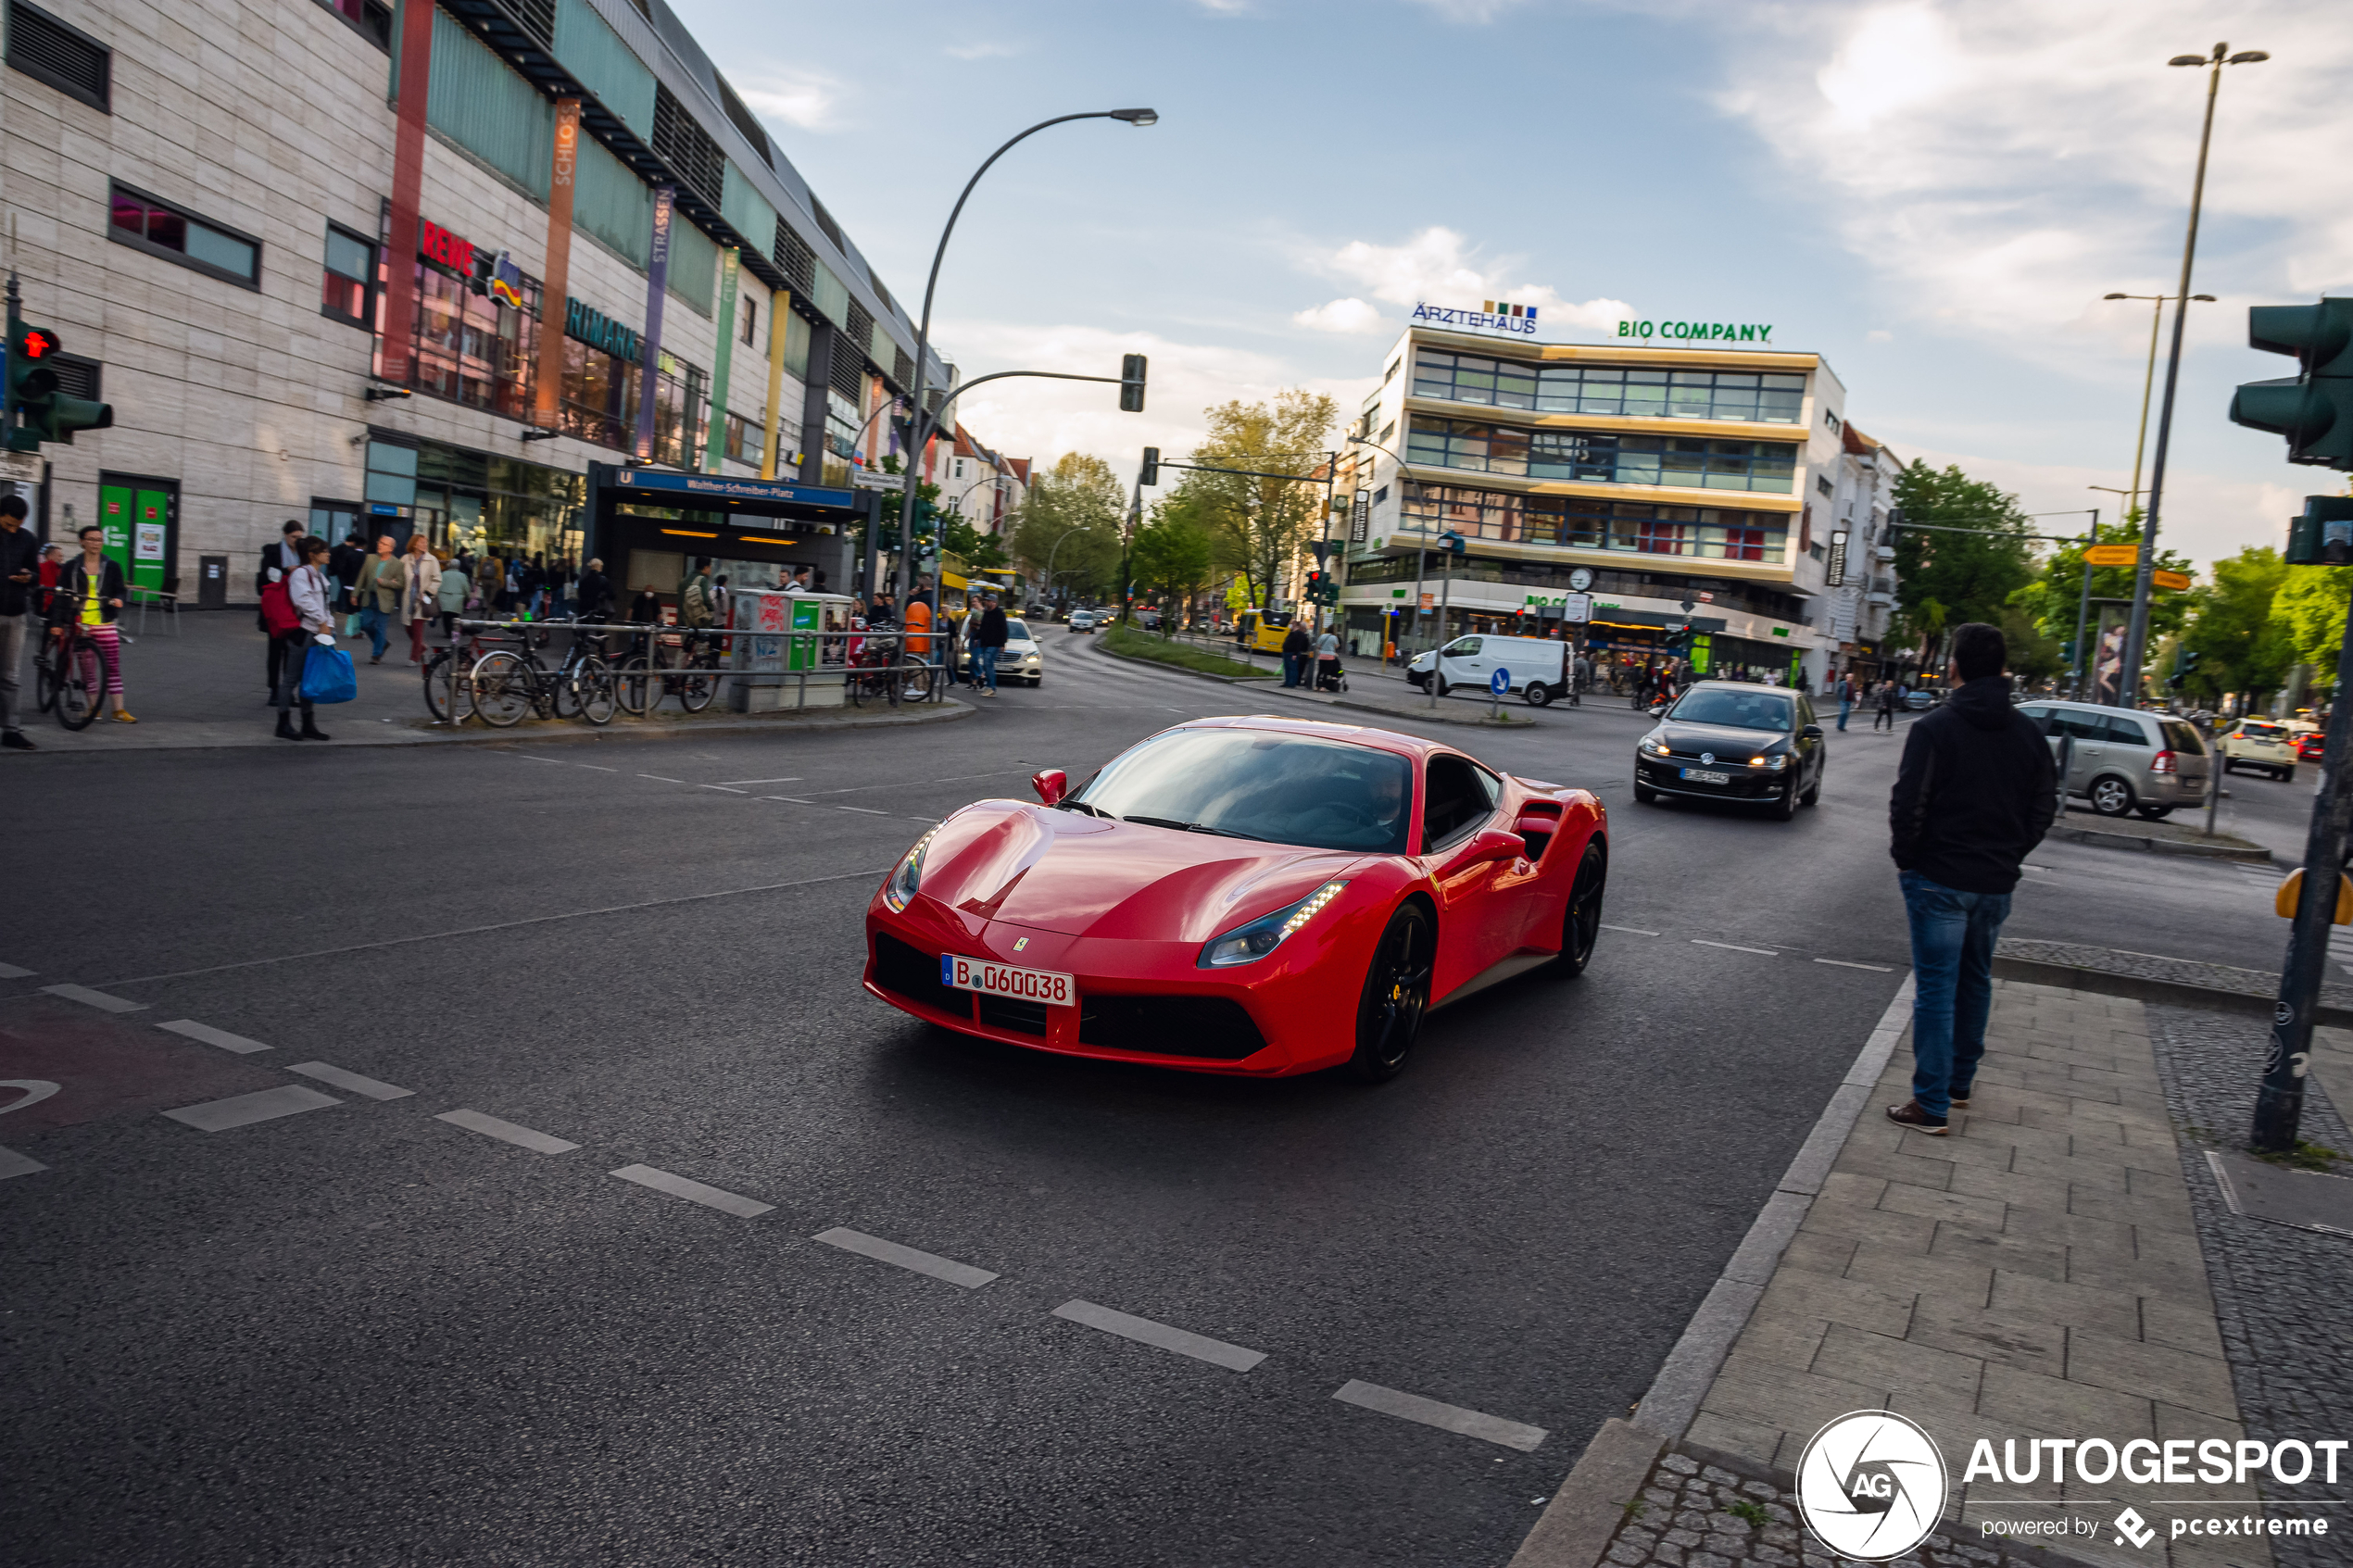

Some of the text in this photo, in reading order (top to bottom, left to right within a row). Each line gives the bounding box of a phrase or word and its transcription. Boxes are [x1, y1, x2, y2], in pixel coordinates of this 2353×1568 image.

[555, 103, 577, 186] SCHLOSS
[422, 220, 474, 278] REWE
[652, 189, 670, 263] STRASSEN
[565, 295, 637, 362] RIMARK
[1412, 301, 1536, 334] ÄRZTEHAUS
[1618, 320, 1773, 342] BIO COMPANY
[620, 470, 795, 499] U Walther-Schreiber-Platz
[957, 960, 1066, 1001] B 060038
